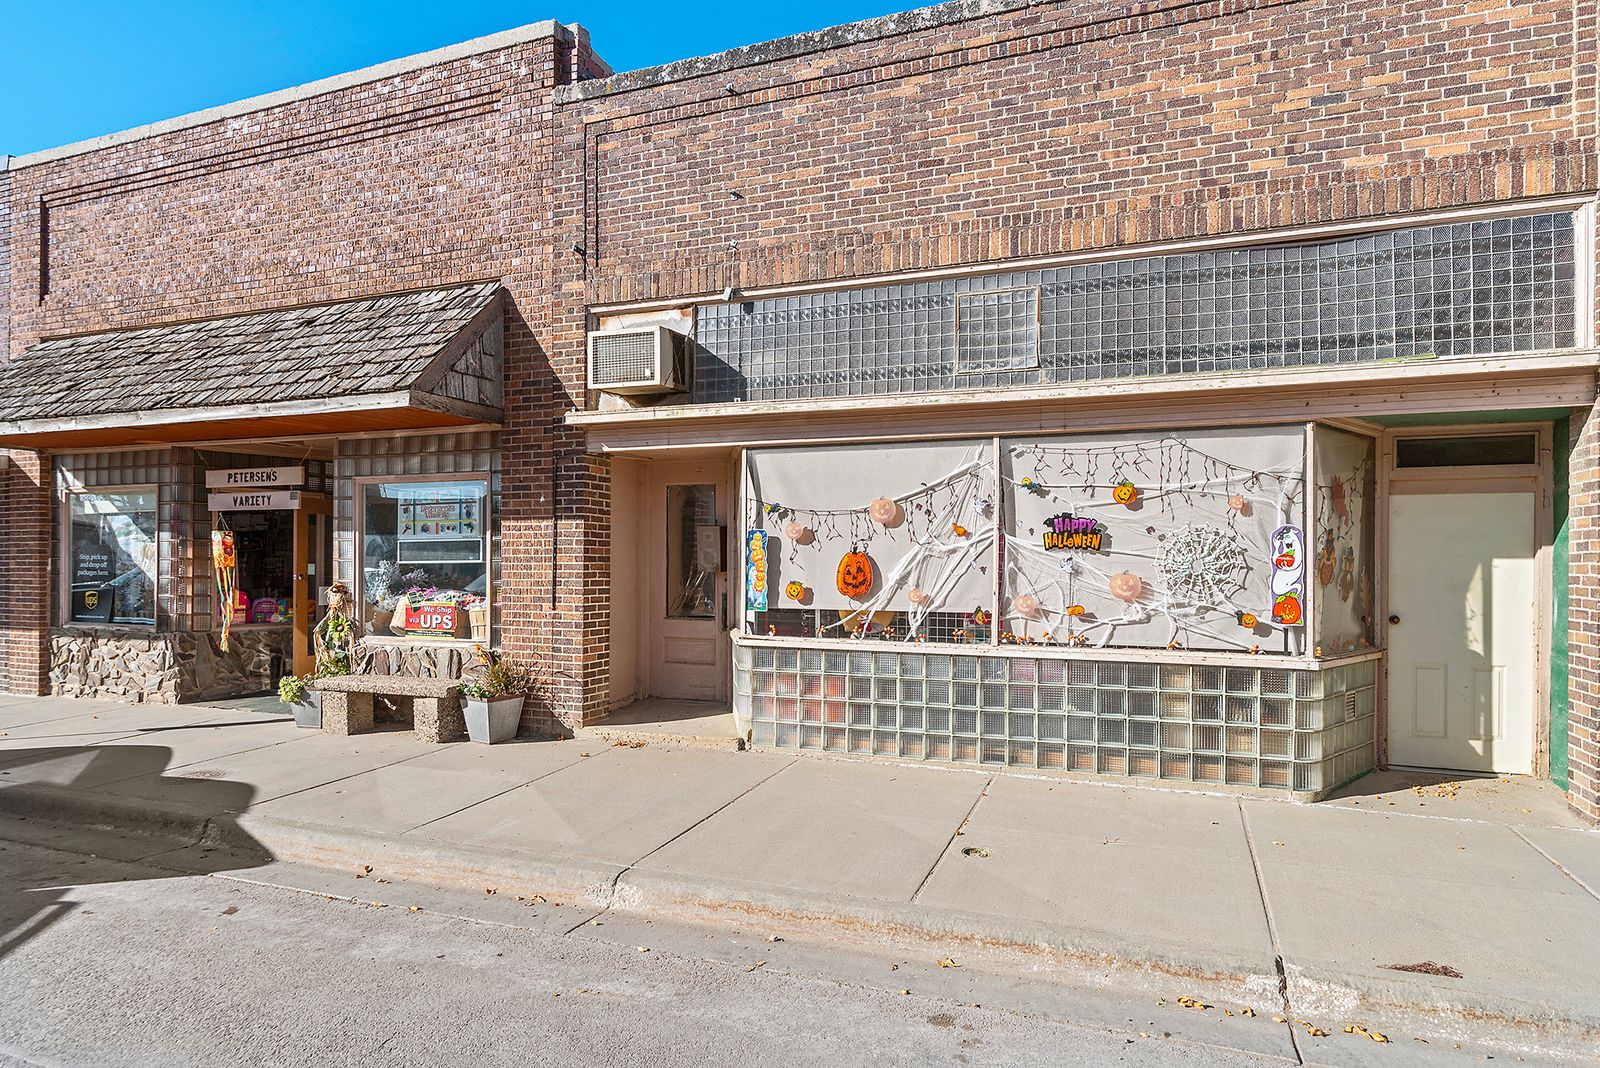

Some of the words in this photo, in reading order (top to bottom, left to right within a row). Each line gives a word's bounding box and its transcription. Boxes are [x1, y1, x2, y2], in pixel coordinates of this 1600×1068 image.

[227, 469, 278, 483] PETERSEN'S
[233, 495, 272, 507] VARIETY
[1053, 517, 1097, 534] HAPPY
[1043, 532, 1102, 550] HALLOWEEN
[437, 606, 452, 614] Ship
[420, 614, 453, 629] UPS
